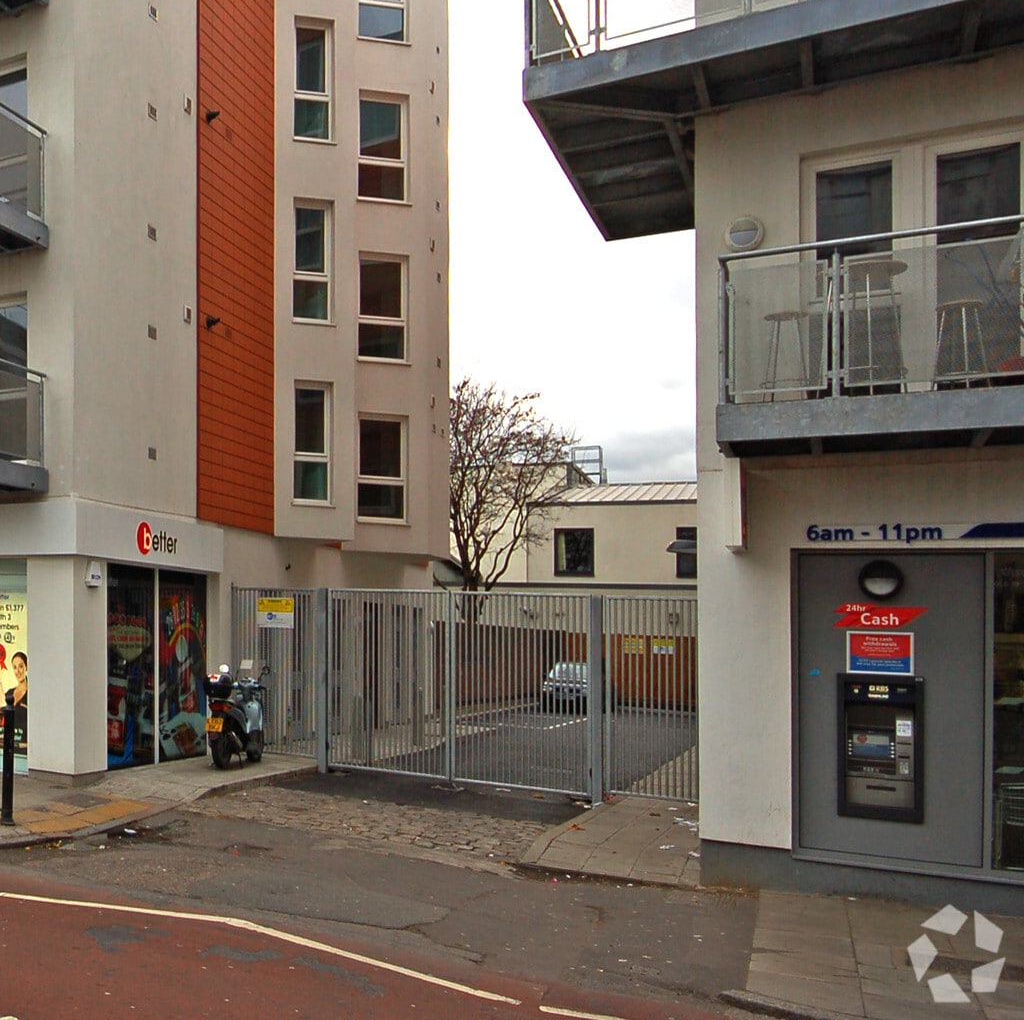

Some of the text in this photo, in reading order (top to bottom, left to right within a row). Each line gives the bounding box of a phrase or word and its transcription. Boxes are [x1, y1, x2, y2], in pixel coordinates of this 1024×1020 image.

[140, 524, 178, 554] better
[806, 524, 854, 541] 6am
[878, 523, 942, 543] 11pm
[846, 604, 866, 612] 24hr
[860, 613, 899, 626] Cash
